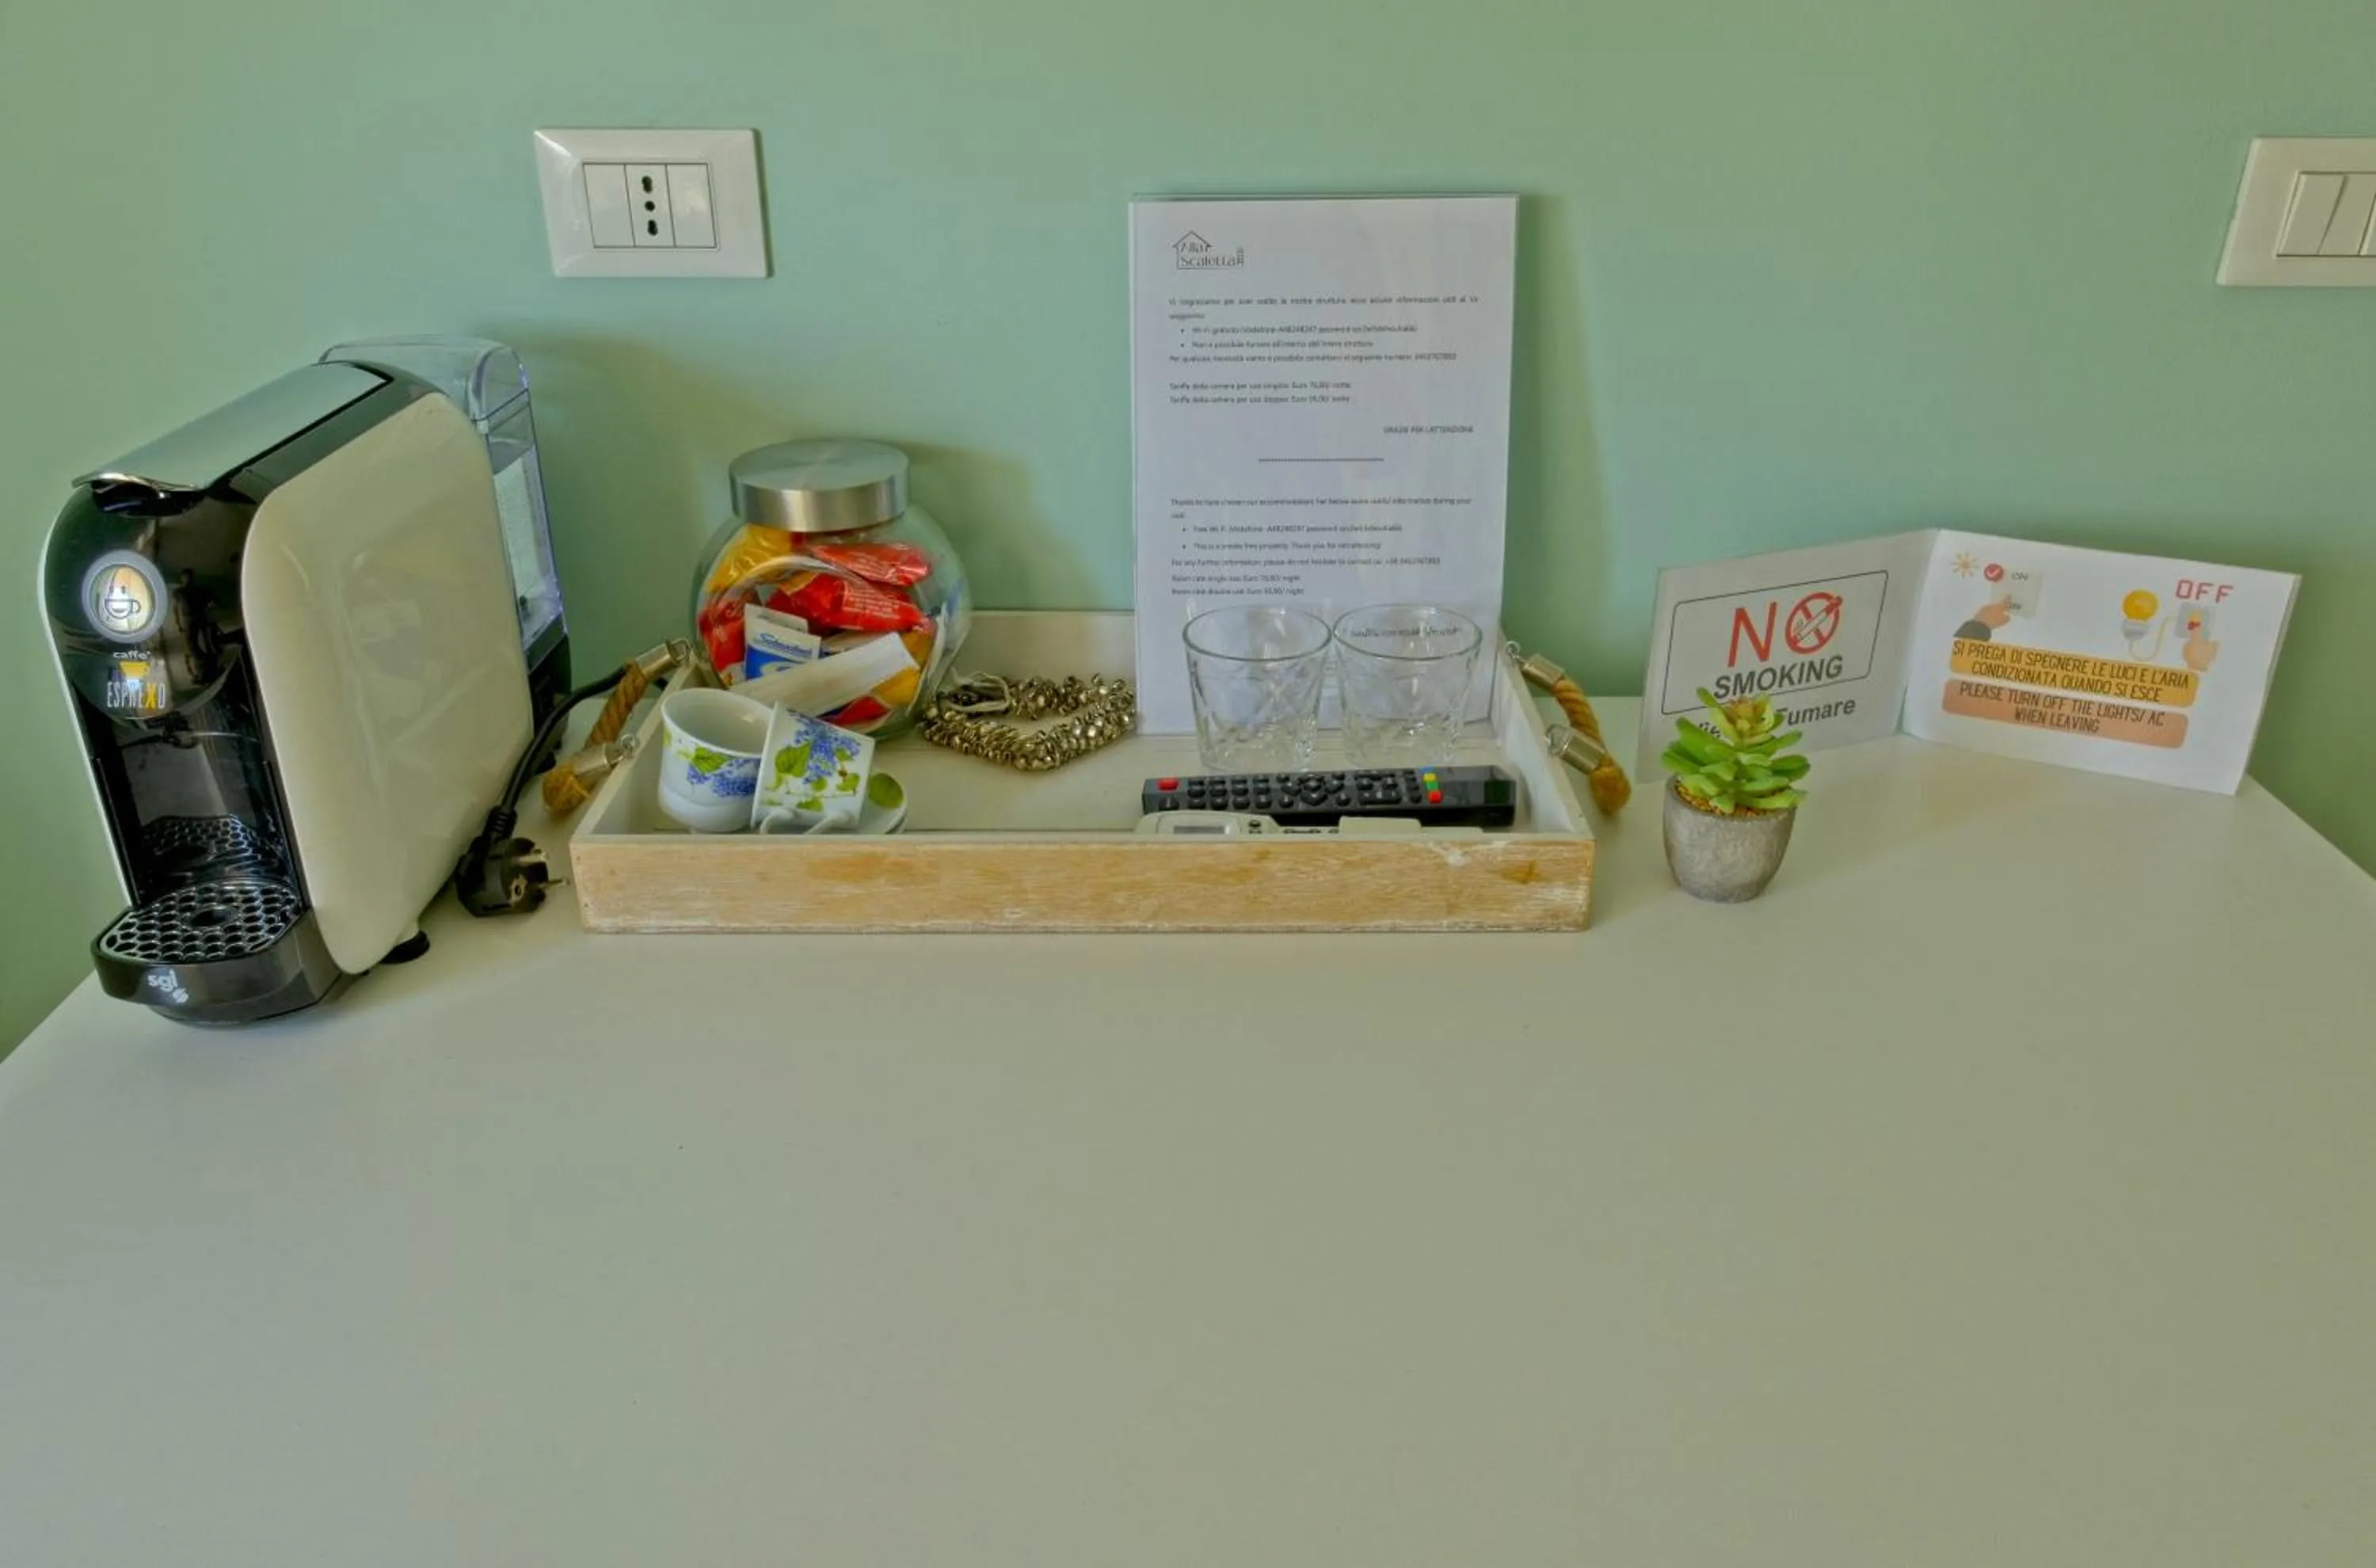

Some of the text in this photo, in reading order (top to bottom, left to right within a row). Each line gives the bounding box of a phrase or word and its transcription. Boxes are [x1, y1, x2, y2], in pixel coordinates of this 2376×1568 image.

[2175, 580, 2234, 605] OFF
[1713, 653, 1845, 699] SMOKING
[1953, 639, 2190, 690] SI PREGA DI SPEGNERE LE LUCI E L'ARIA
[1971, 660, 2164, 702] CONDIZIONATA QUANDO SI ESCE
[1959, 681, 2005, 702] PLEASE
[2007, 688, 2041, 707] TURN
[2042, 694, 2069, 710] OFF
[2070, 698, 2096, 716] THE
[2147, 710, 2166, 727] AC
[2015, 706, 2100, 734] WHEN LEAVING
